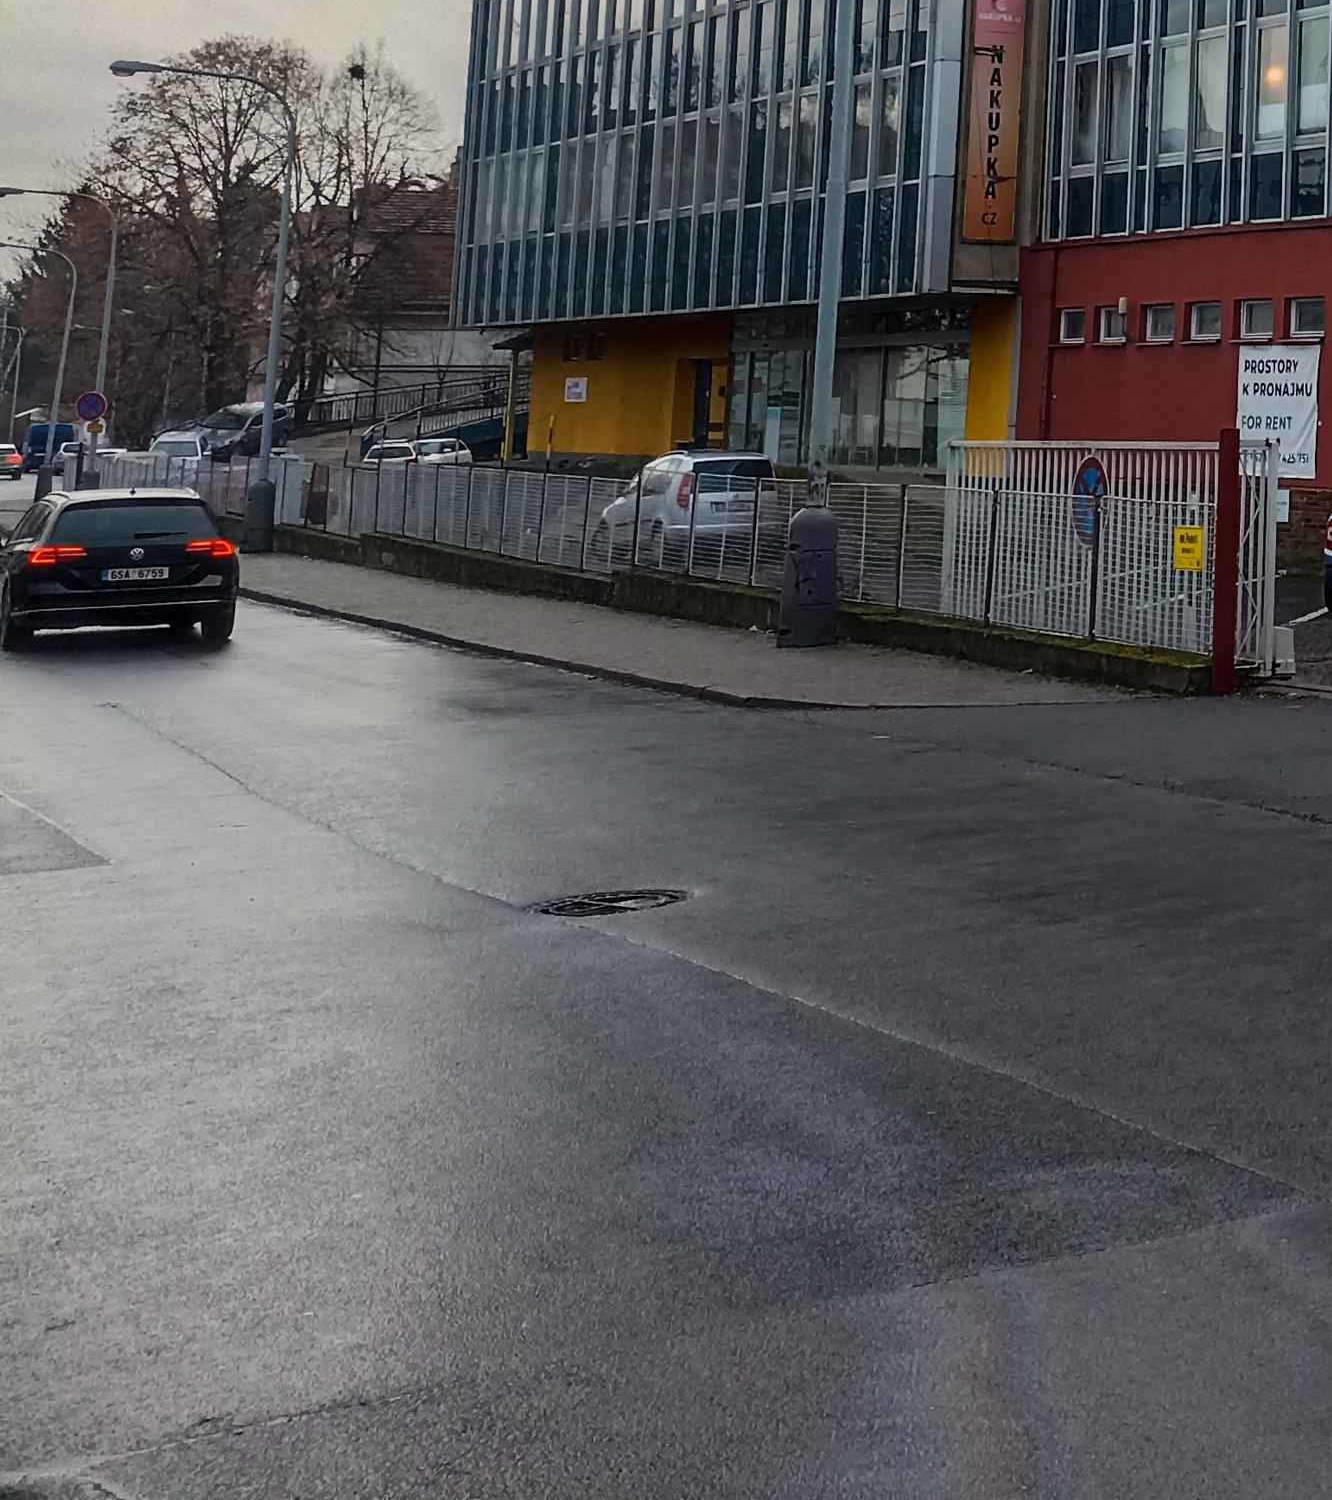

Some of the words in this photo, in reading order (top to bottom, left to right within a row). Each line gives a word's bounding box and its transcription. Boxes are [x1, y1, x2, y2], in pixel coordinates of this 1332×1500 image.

[984, 45, 1004, 199] NAKUPKA
[1244, 359, 1298, 374] PROSTORY
[1242, 383, 1249, 395] K
[1242, 415, 1261, 429] FOR
[1266, 416, 1292, 430] RENT
